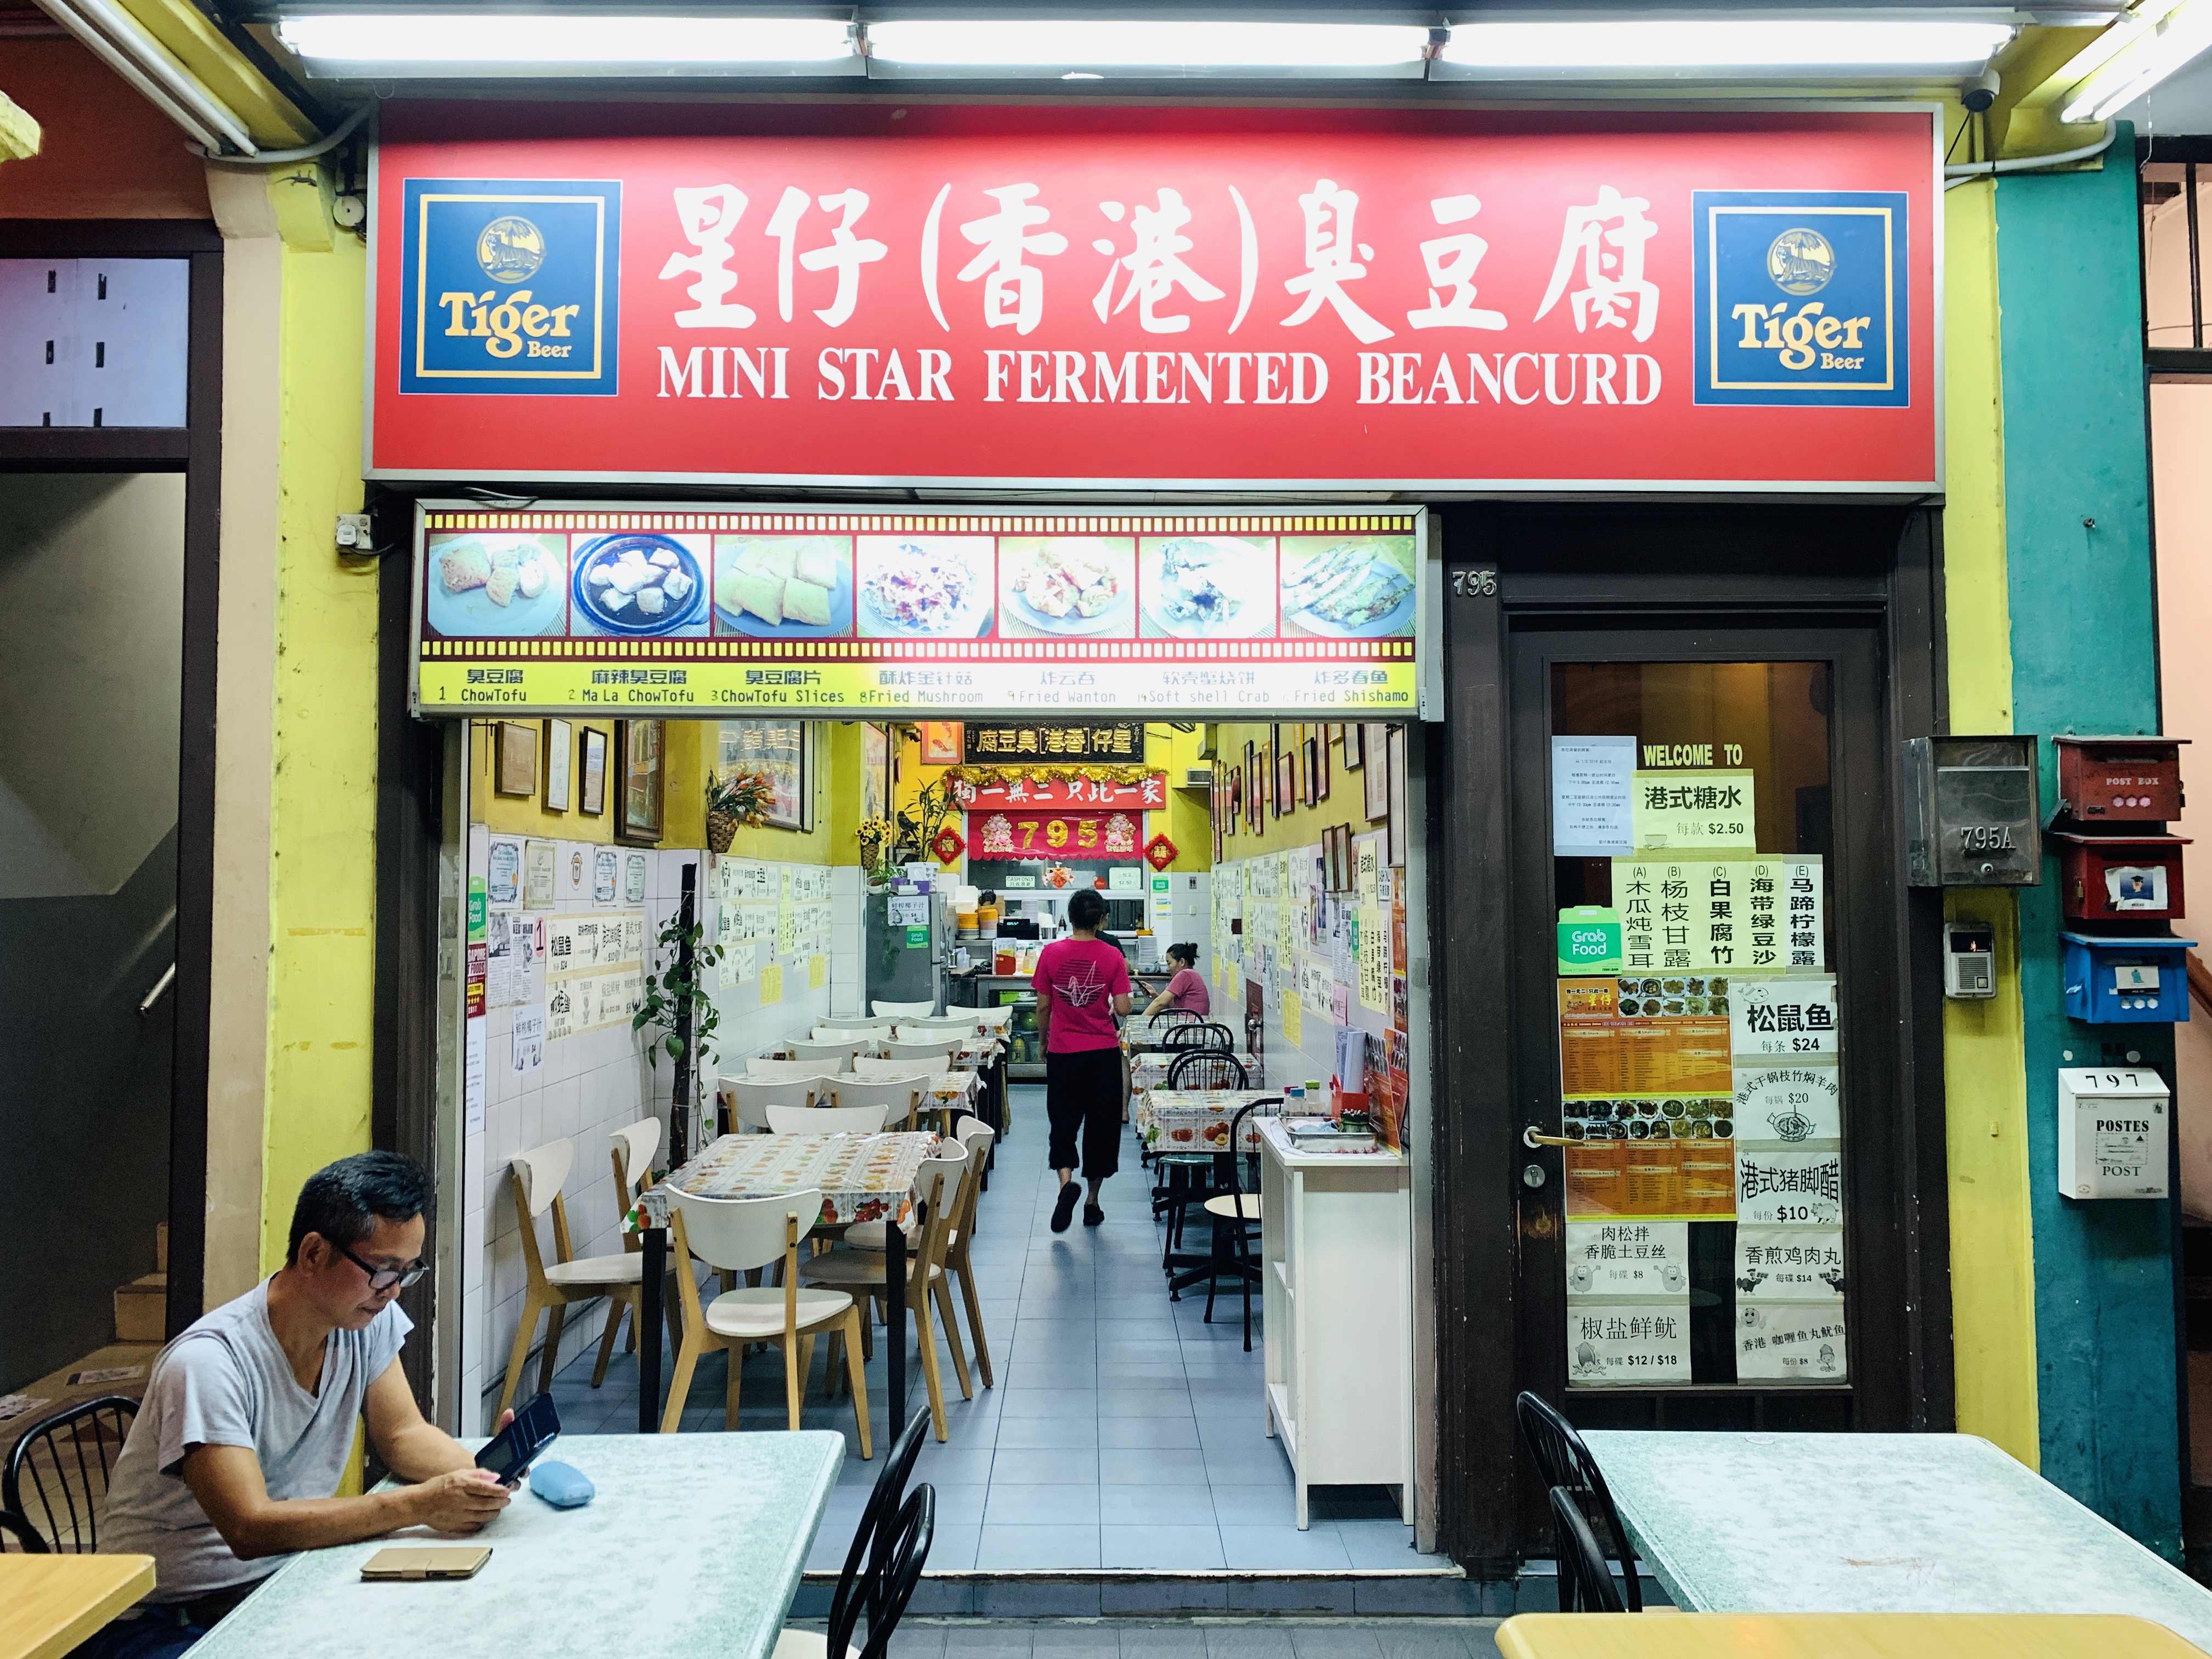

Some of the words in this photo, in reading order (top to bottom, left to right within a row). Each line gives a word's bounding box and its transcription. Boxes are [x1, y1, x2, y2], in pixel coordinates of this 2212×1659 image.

[658, 179, 1660, 344] 星仔(香港)臭豆腐
[439, 290, 579, 359] Tiger
[1731, 302, 1871, 370] Tiger
[527, 341, 572, 359] Beer
[1820, 352, 1864, 371] Beer
[657, 346, 790, 400] MINI
[817, 347, 955, 402] STAR
[984, 349, 1328, 405] FERMENTED
[1356, 352, 1662, 405] BEANCURD
[1452, 571, 1497, 596] 795
[467, 669, 523, 684] 臭豆腐
[592, 670, 686, 685] 麻辣臭豆腐
[746, 670, 821, 685] 臭豆腐片
[1041, 671, 1095, 685] 炸云吞
[1314, 670, 1388, 685] 炸多春鱼
[439, 686, 446, 701] 1
[461, 689, 527, 702] ChowTofu
[568, 689, 575, 700] 2
[582, 689, 598, 702] Ma
[603, 689, 618, 702] La
[628, 689, 694, 702] ChowTofu
[711, 690, 718, 701] 3
[721, 690, 787, 702] ChowTofu
[797, 690, 844, 703] Slices
[860, 691, 867, 703] 8
[869, 690, 910, 703] Fried
[918, 691, 983, 703] Mushroom
[1019, 691, 1059, 703] Fried
[1068, 691, 1116, 703] Wanton
[1149, 691, 1180, 703] Soft
[1190, 691, 1227, 703] shell
[1238, 691, 1269, 703] Crab
[1295, 690, 1335, 702] Fried
[1344, 690, 1409, 702] Shishamo
[1643, 744, 1713, 766] WELCOME
[1724, 744, 1743, 765] TO
[2106, 777, 2131, 786] POST
[1065, 778, 1163, 805] 只此一家
[1645, 786, 1742, 810] 港式糖水
[1018, 820, 1097, 849] 795
[1676, 822, 1703, 836] 每款
[1708, 822, 1743, 836] $2.50
[1960, 826, 2016, 850] 795A
[1633, 867, 1646, 879] (A)
[1668, 866, 1681, 879] (B)
[1713, 866, 1726, 879] (C)
[1755, 865, 1768, 878] (D)
[1796, 865, 1809, 878] (E)
[469, 899, 481, 911] Grab
[469, 911, 482, 922] Food
[1710, 879, 1734, 964] 白果腐竹
[1750, 878, 1777, 965] 海带绿豆沙
[1790, 878, 1816, 966] 马蹄柠檬露
[1626, 881, 1654, 968] 木瓜炖雪耳
[1661, 881, 1691, 968] 杨枝甘露
[537, 920, 543, 951] 1
[1572, 929, 1606, 943] Grab
[551, 935, 571, 957] 松鼠鱼
[1572, 943, 1606, 955] Food
[1747, 1003, 1834, 1033] 松鼠鱼
[1761, 1041, 1785, 1053] 每条
[1792, 1038, 1820, 1052] $24
[2085, 1074, 2138, 1088] 797
[1788, 1093, 1809, 1104] $20
[2096, 1120, 2149, 1132] POSTES
[2102, 1166, 2142, 1176] POST
[1741, 1158, 1838, 1203] 港式猪脚醋
[1754, 1211, 1773, 1221] 每份
[1777, 1205, 1808, 1223] $10
[1602, 1226, 1650, 1242] 肉松拌
[1584, 1244, 1666, 1260] 香脆土豆丝
[1745, 1246, 1841, 1265] 香煎鸡肉丸
[1634, 1271, 1643, 1279] $8
[1581, 1317, 1677, 1340] 椒盐鲜鱿
[1742, 1337, 1766, 1352] 香港
[1628, 1355, 1647, 1365] $12
[1657, 1355, 1677, 1365] $18
